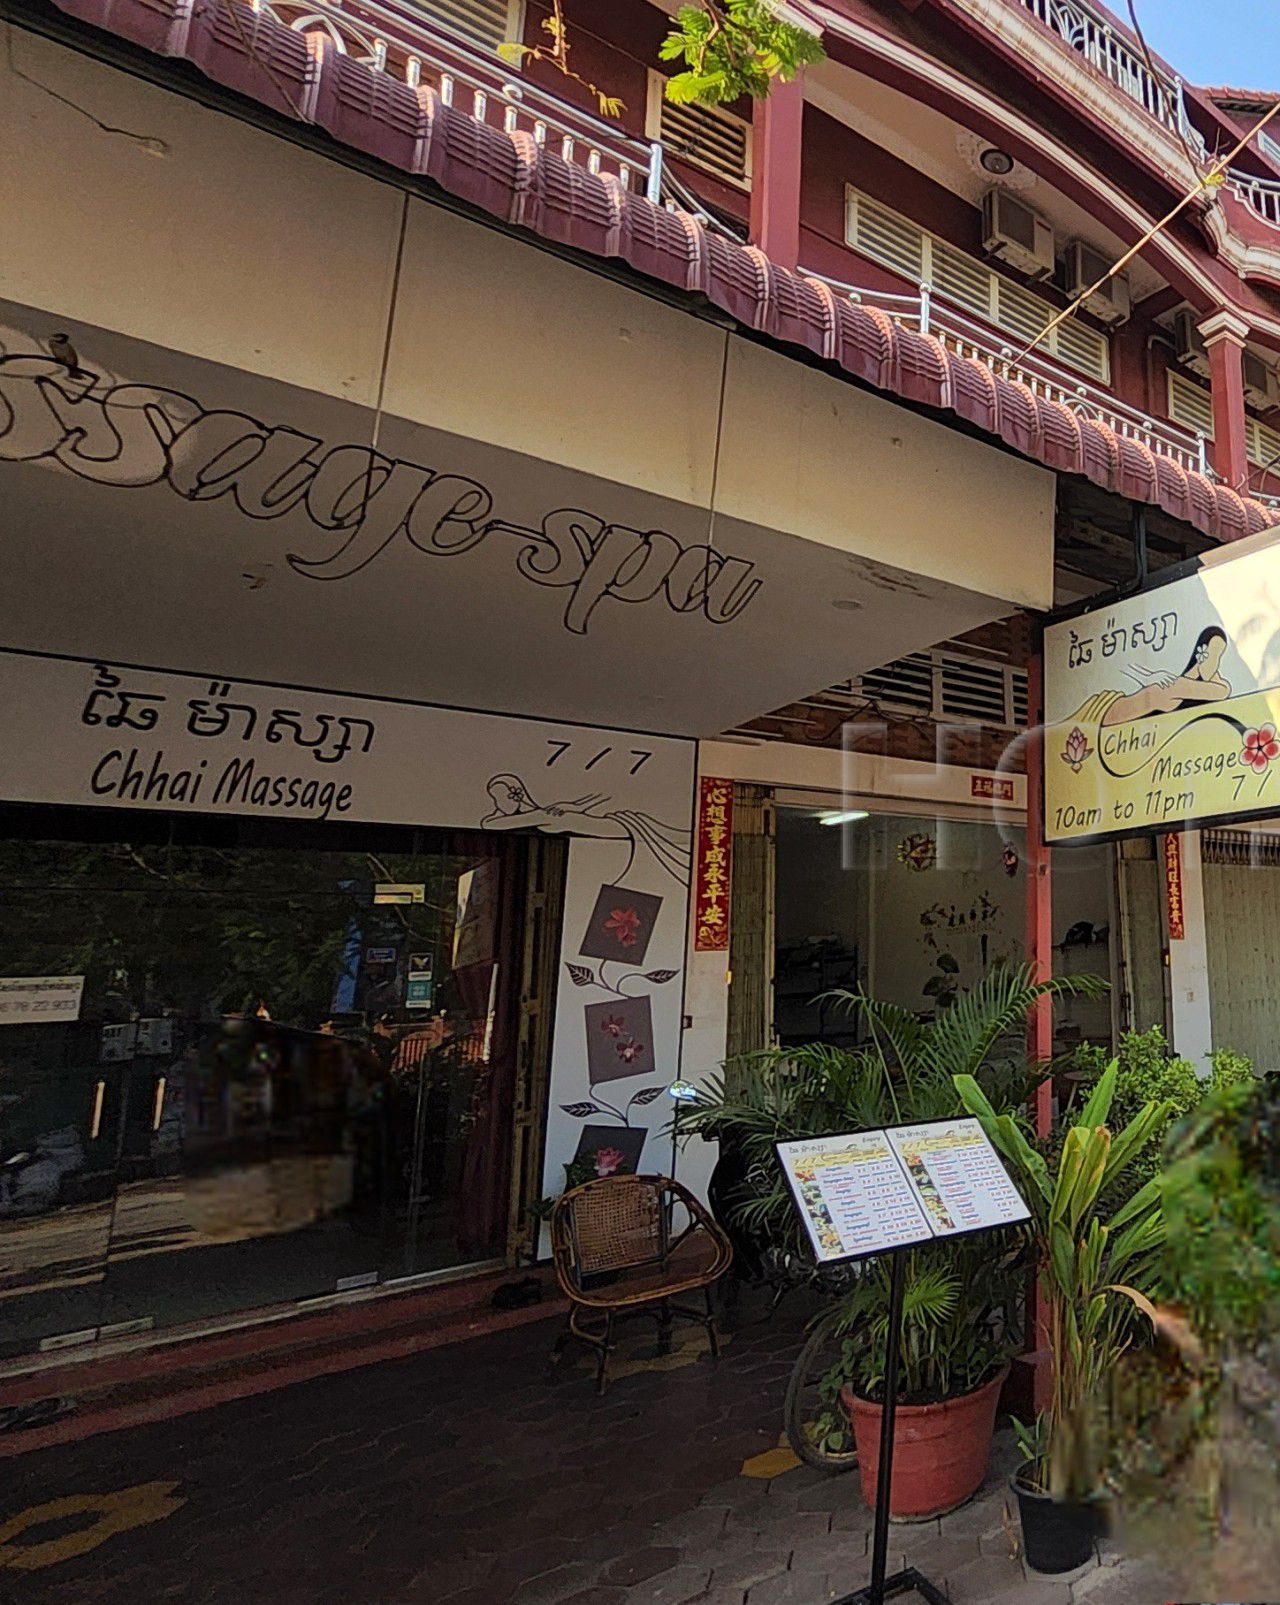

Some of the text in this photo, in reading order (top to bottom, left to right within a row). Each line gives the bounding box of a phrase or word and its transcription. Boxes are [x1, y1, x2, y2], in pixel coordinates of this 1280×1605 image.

[1103, 725, 1158, 756] Chhai
[91, 748, 353, 821] Chhai Massage
[1151, 750, 1238, 784] Massage
[1054, 789, 1195, 831] 10am to 11pm
